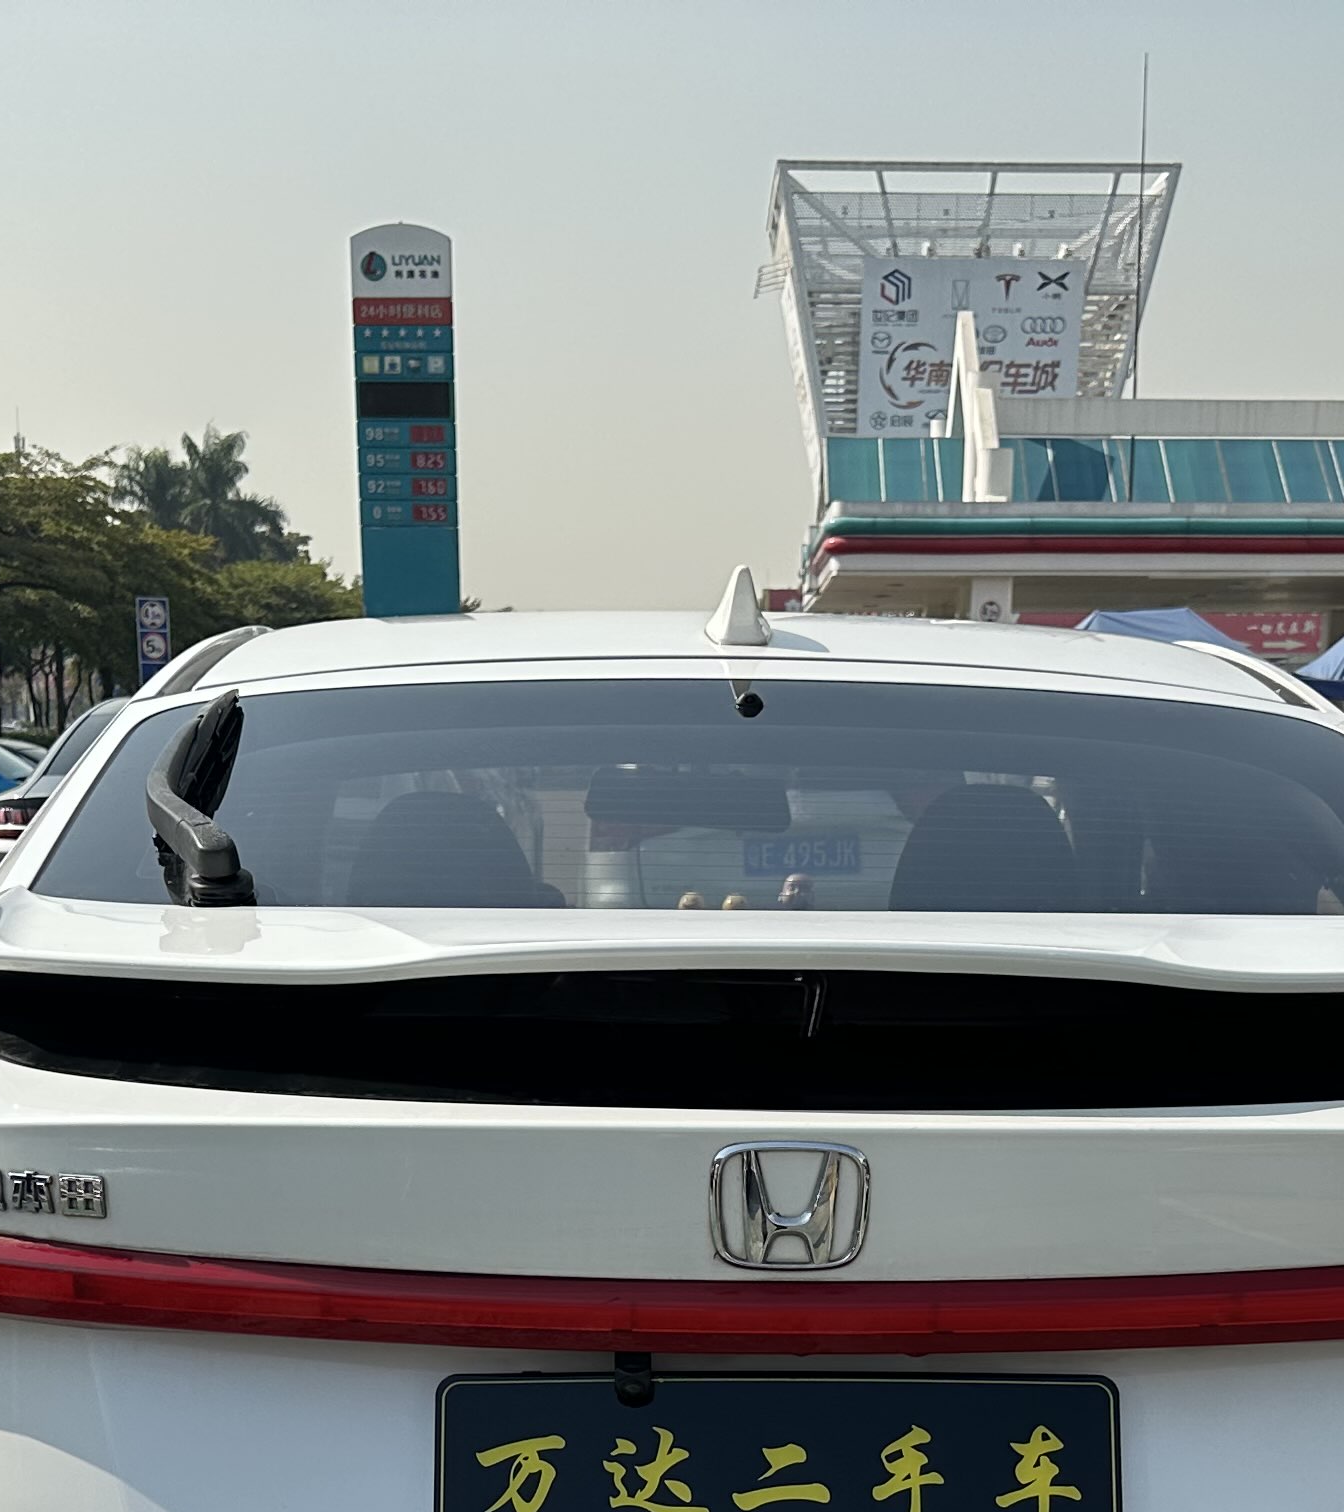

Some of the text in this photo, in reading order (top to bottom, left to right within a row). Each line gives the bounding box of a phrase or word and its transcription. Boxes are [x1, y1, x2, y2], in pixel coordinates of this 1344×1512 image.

[1025, 337, 1059, 348] Audi
[901, 359, 1060, 395] 华南车城
[365, 427, 384, 441] 98
[366, 454, 385, 468] 95
[367, 480, 385, 494] 92
